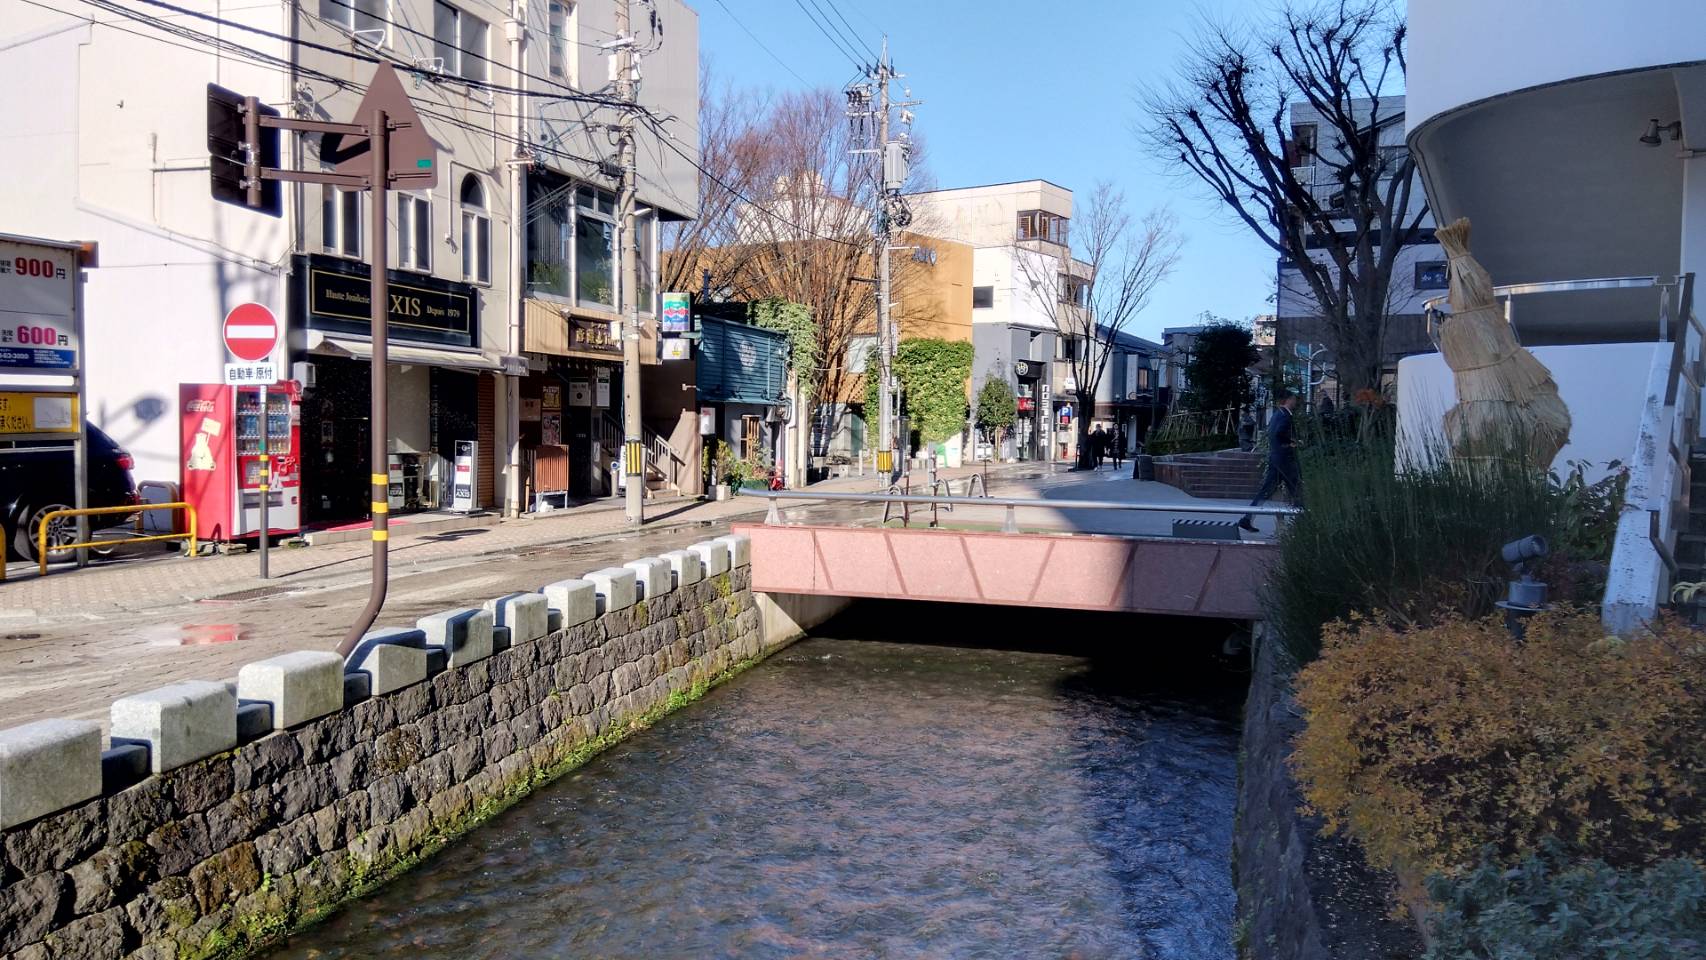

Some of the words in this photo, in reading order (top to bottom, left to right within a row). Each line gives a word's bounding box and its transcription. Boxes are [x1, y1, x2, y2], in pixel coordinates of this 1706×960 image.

[387, 294, 421, 317] XIS
[426, 305, 445, 317] Depuis
[447, 308, 461, 318] 1979
[1041, 384, 1050, 447] COMPLETE
[1061, 407, 1069, 416] P
